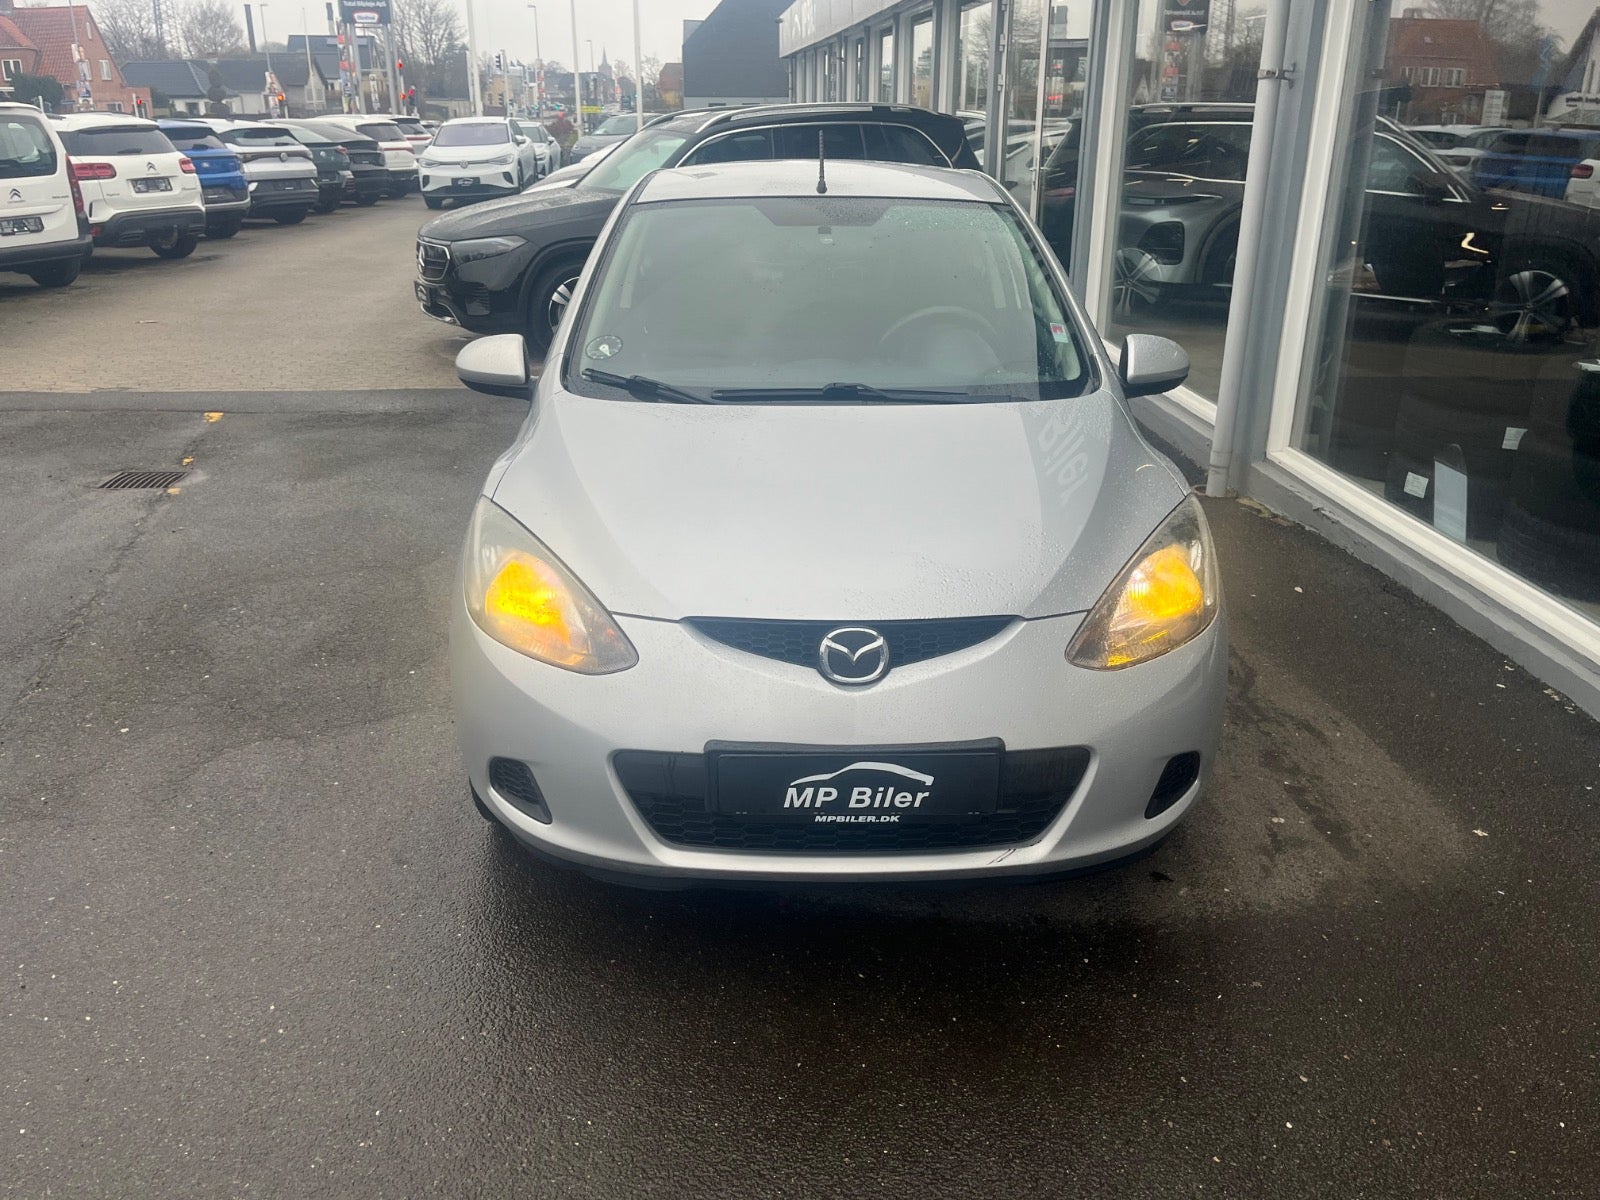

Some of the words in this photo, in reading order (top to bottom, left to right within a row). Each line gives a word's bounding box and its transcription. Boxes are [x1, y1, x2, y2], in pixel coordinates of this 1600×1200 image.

[784, 787, 838, 808] MP
[848, 787, 930, 808] Biler
[814, 815, 900, 823] MPBILER.DK
